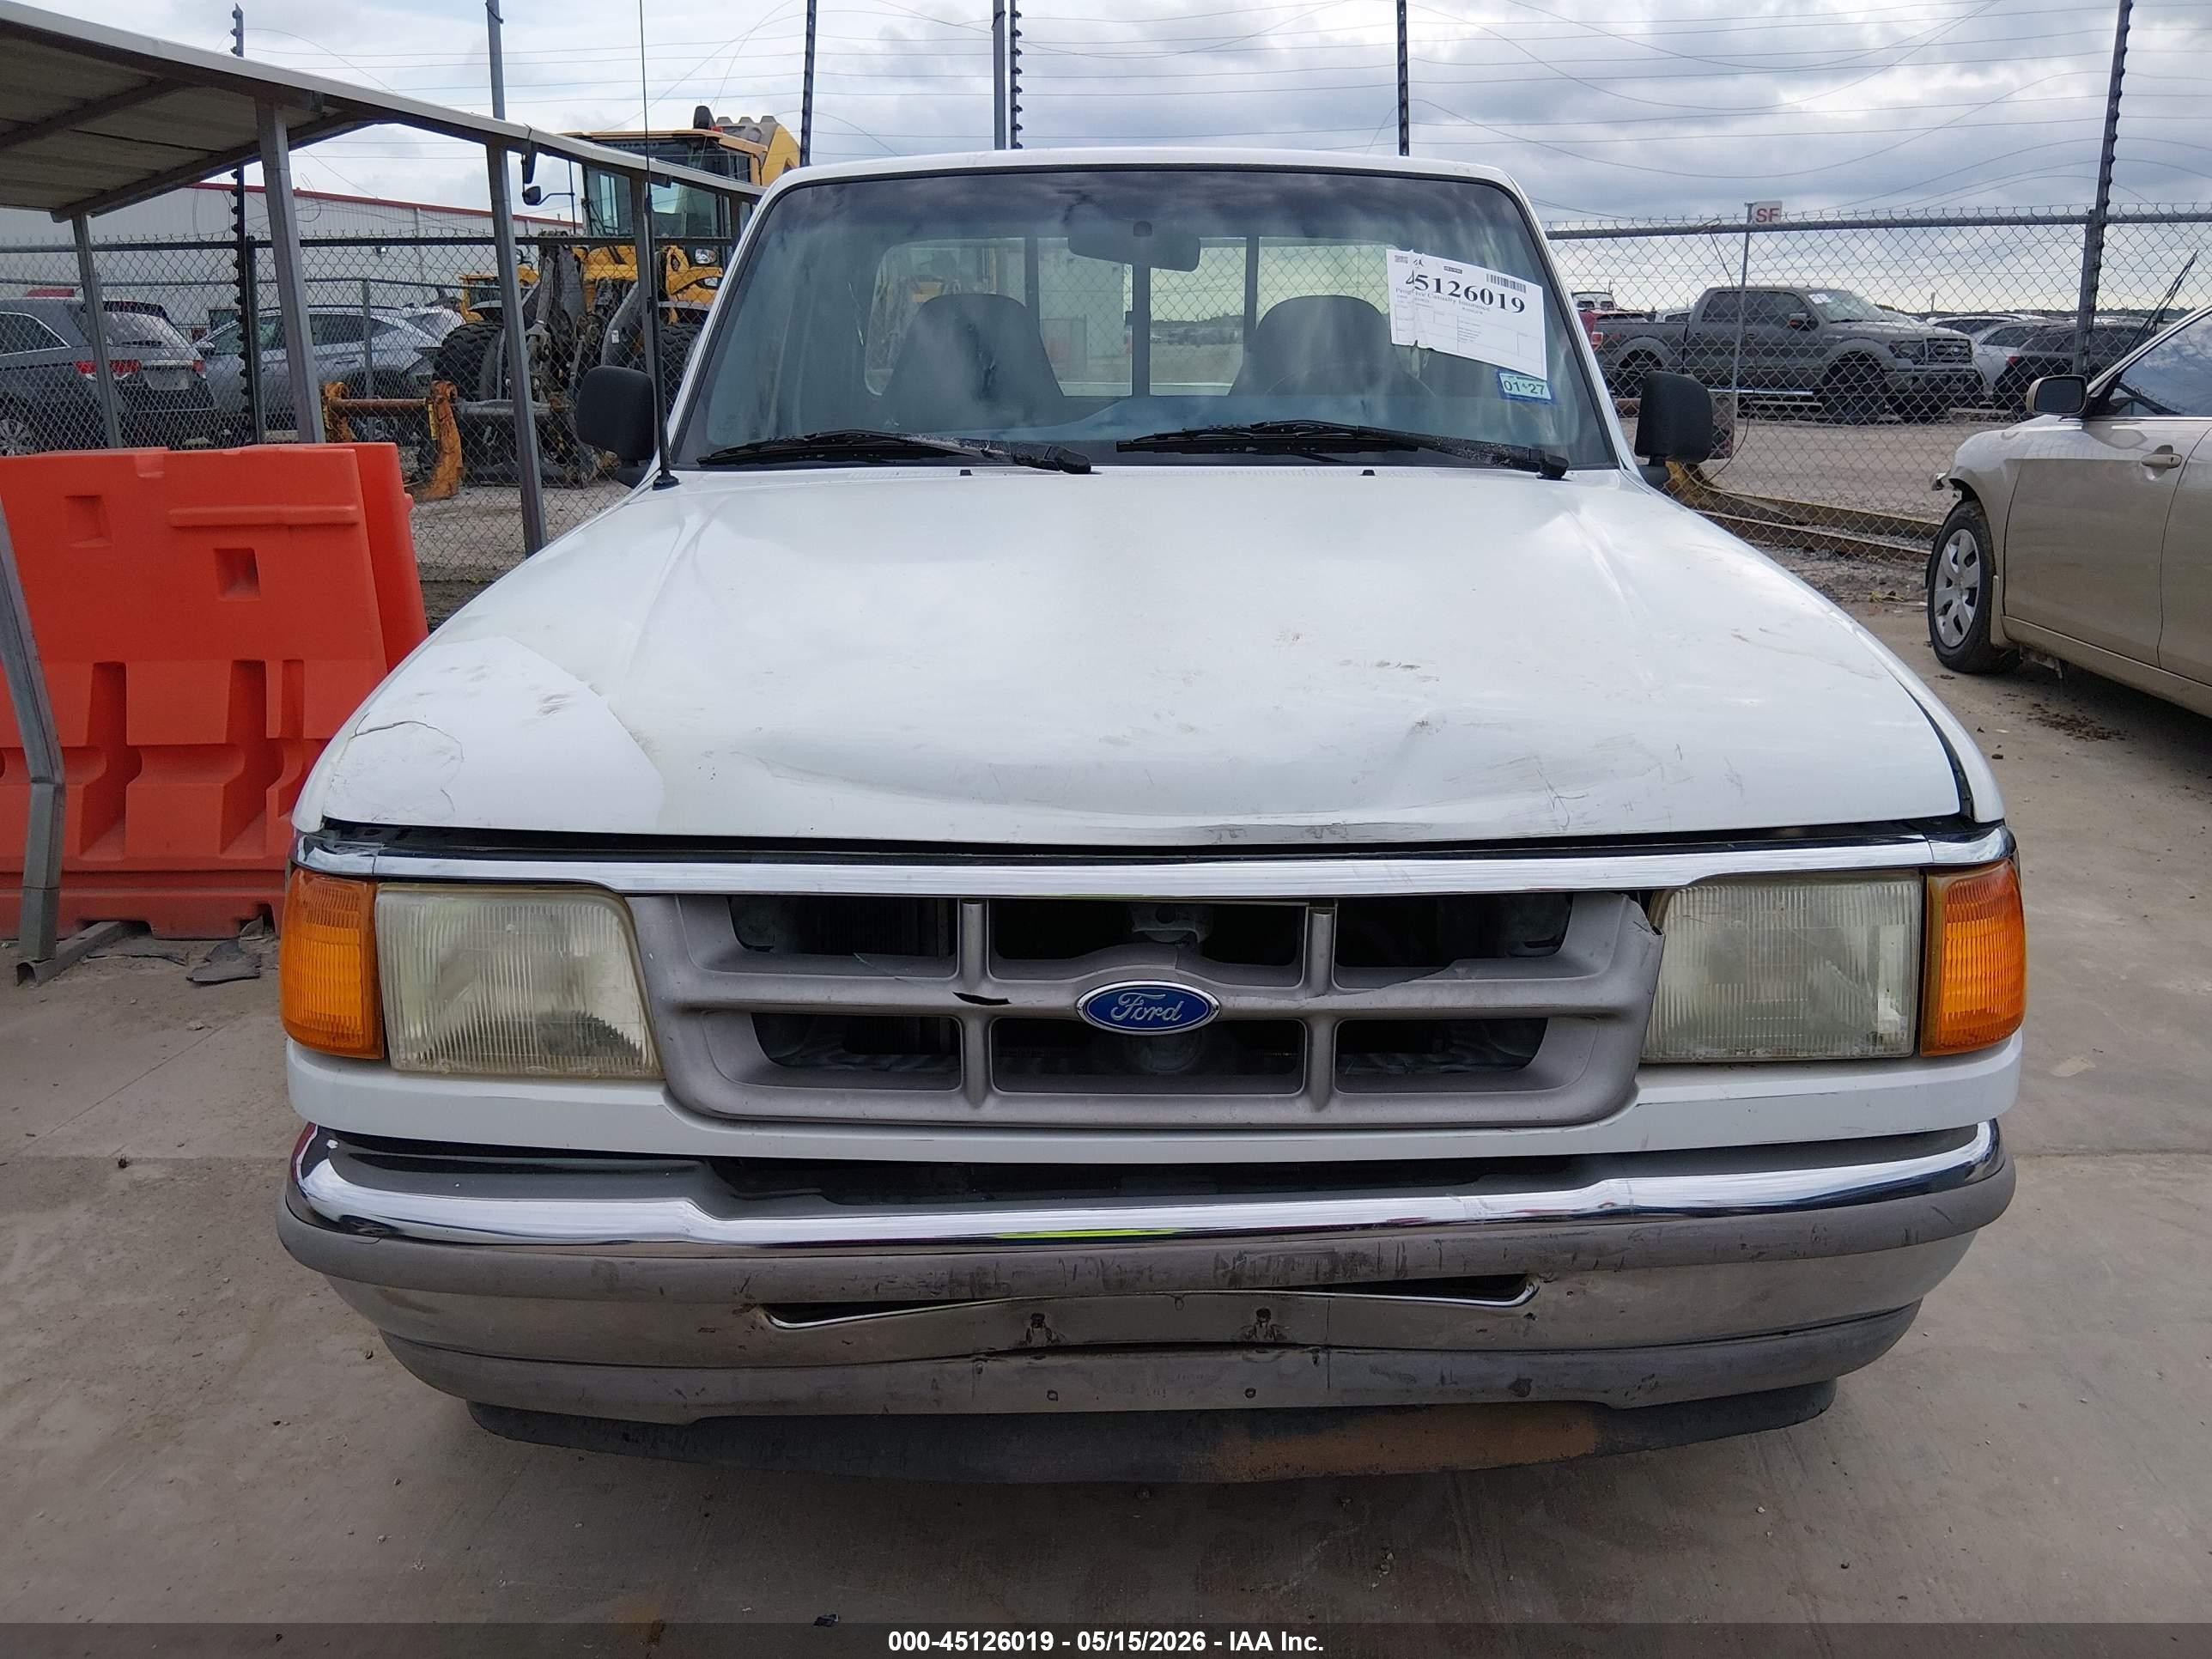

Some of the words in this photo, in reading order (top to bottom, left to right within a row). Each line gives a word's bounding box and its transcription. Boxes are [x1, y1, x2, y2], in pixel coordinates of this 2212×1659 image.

[1756, 208, 1780, 223] SF
[1504, 380, 1521, 392] 01
[1528, 383, 1545, 396] 27
[1110, 992, 1184, 1022] Ford
